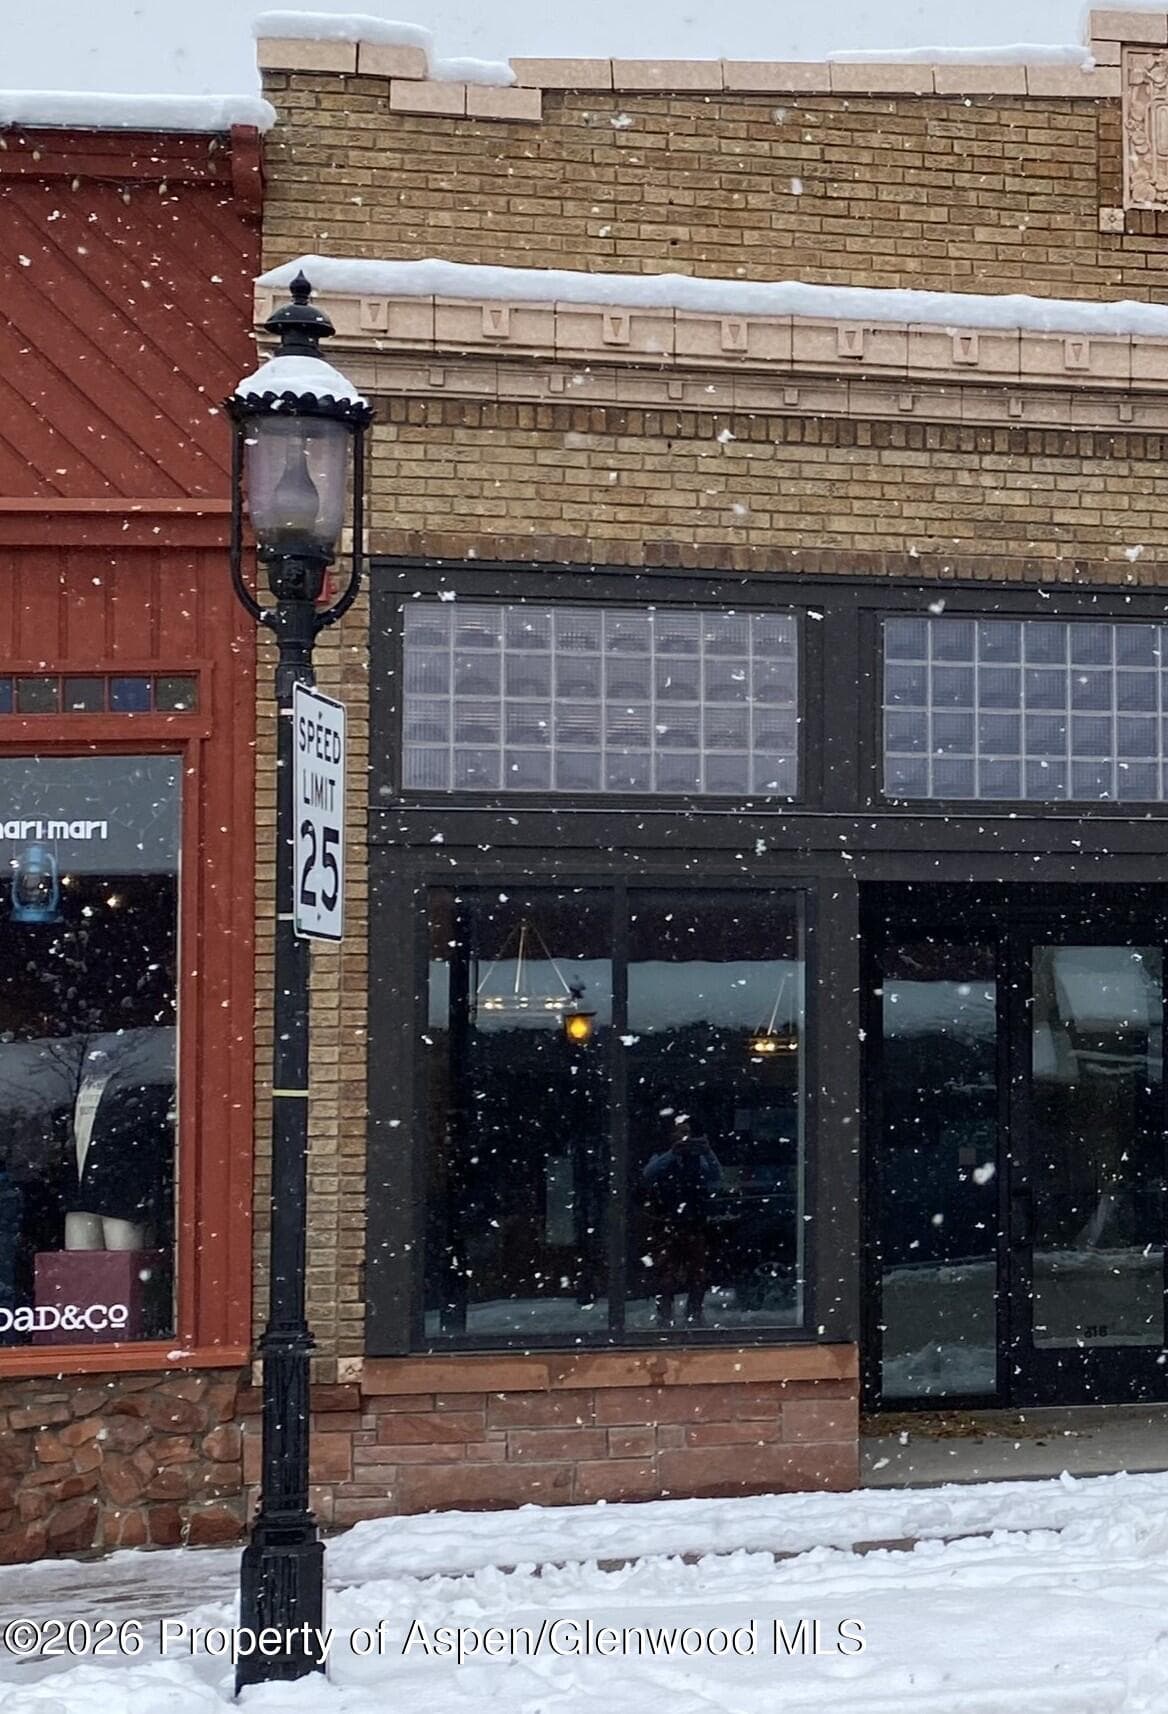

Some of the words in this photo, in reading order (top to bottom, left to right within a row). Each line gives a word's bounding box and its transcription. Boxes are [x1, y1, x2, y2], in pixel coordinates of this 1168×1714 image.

[299, 716, 341, 764] SPEED
[303, 768, 336, 812] LIMIT
[0, 820, 42, 839] ari
[47, 820, 108, 839] mari
[300, 819, 340, 912] 25
